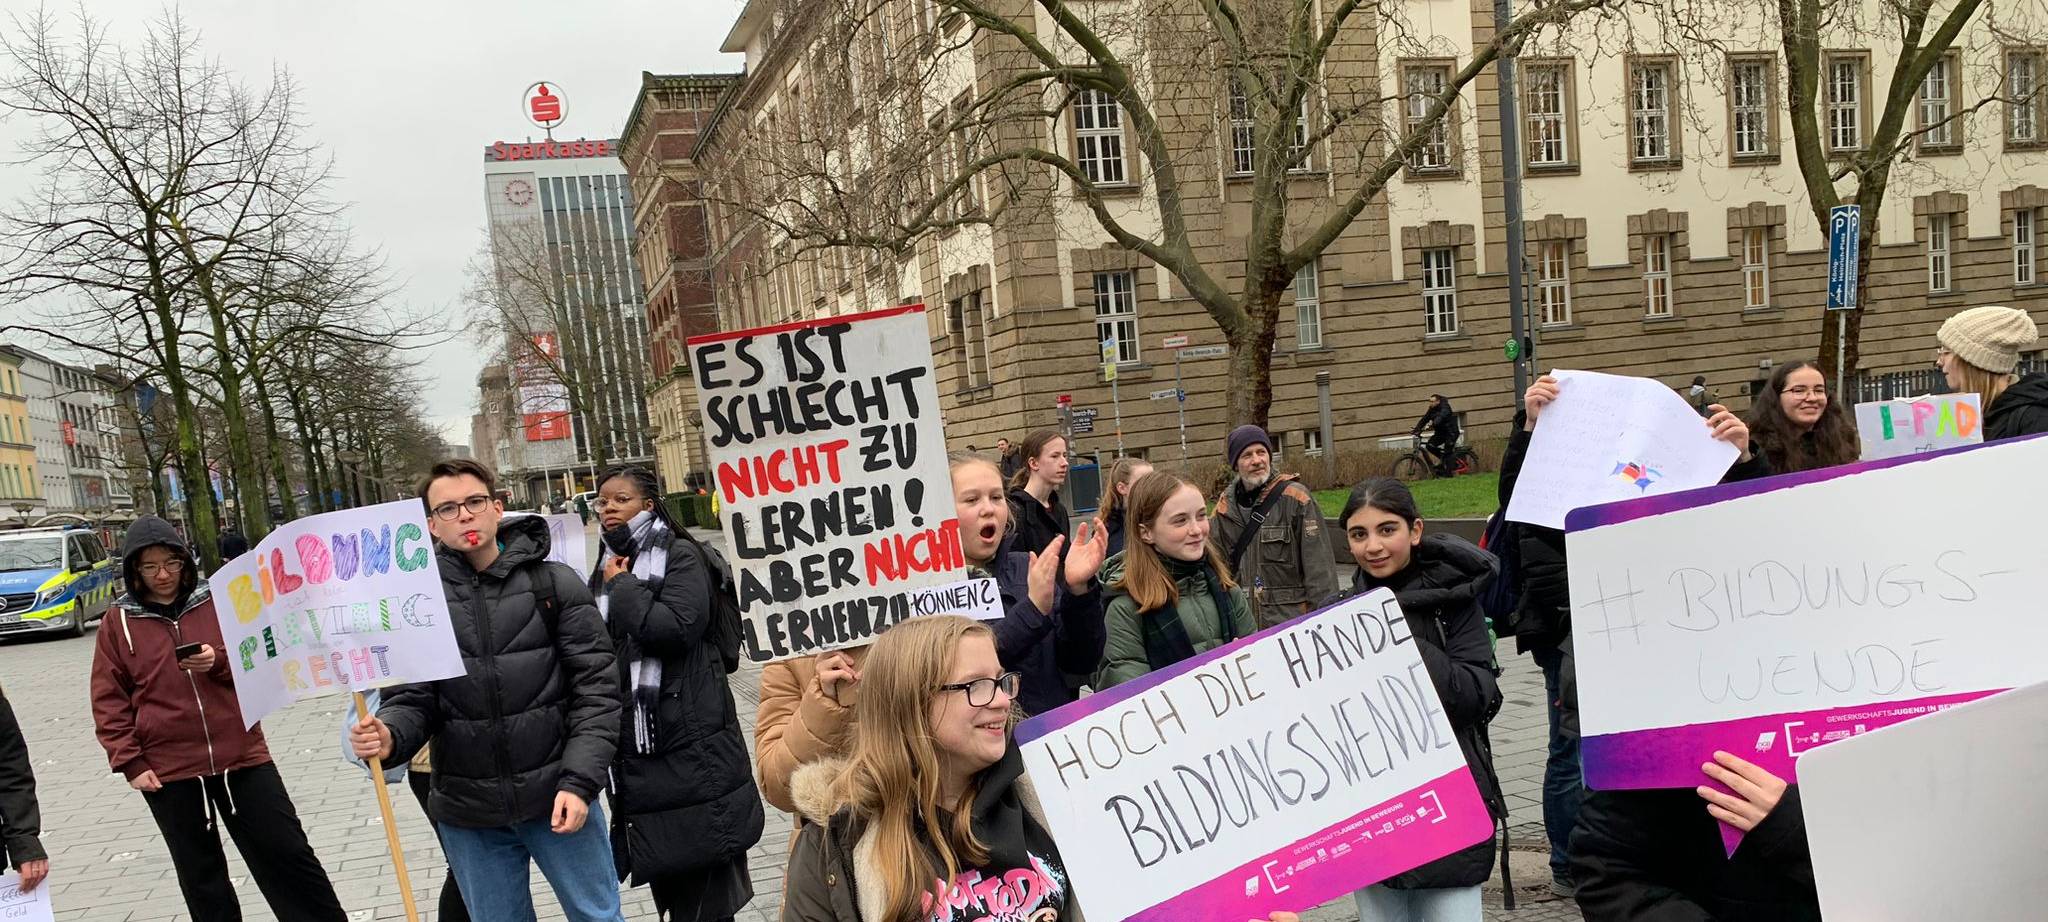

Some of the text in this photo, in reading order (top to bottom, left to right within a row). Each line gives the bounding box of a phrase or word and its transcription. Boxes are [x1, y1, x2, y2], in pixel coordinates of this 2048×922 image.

[494, 140, 609, 161] Sparkasse
[1835, 218, 1845, 234] P
[1851, 217, 1857, 232] P
[696, 323, 851, 390] ES IST
[707, 366, 927, 448] SCHLECHT
[1880, 400, 1978, 440] I-PAD
[717, 423, 917, 504] NICHT ZU
[740, 518, 965, 613] ABER NICHT
[282, 645, 390, 692] RECHT
[1045, 597, 1413, 791] HOCH DIE HÄNDE
[1698, 637, 1947, 704] WENDE
[1826, 706, 1926, 723] GEWERKSCHAFTSJUGEND
[1927, 704, 1938, 713] IN
[1104, 659, 1451, 868] BILDUNGSWENDE
[6, 905, 27, 918] Geld
